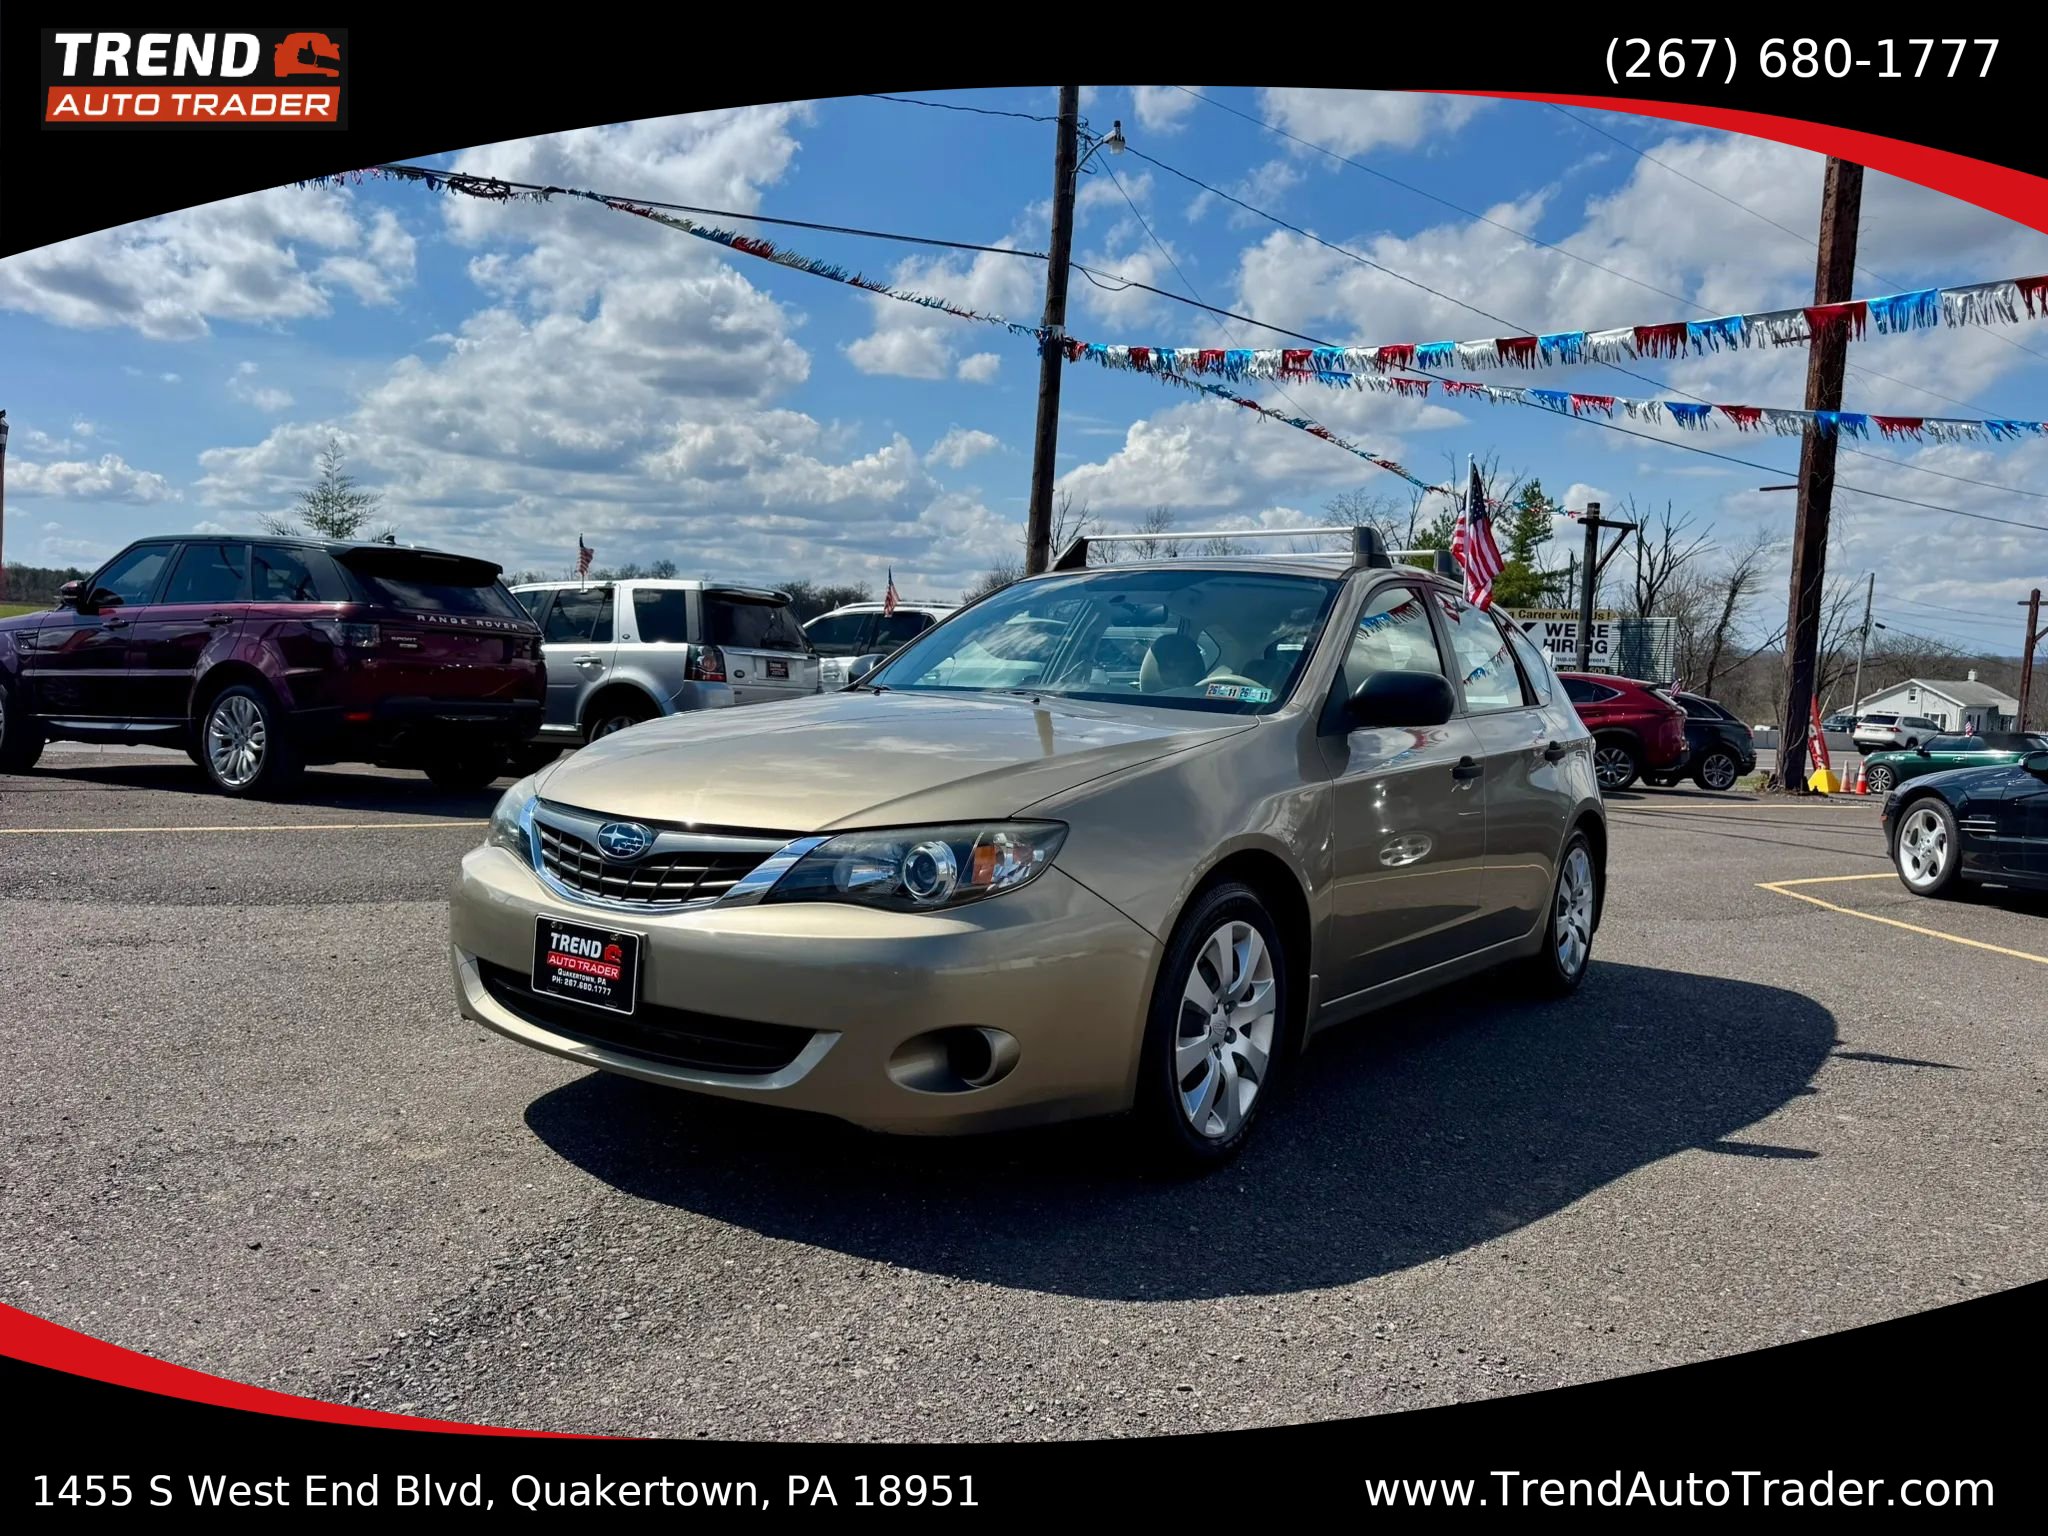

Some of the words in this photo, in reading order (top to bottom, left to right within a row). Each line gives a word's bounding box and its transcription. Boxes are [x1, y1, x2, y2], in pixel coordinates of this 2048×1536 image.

[416, 614, 468, 625] RANGE
[476, 620, 518, 630] ROVER
[1518, 609, 1557, 619] Career
[1561, 610, 1579, 619] wit
[551, 932, 602, 959] TREND
[549, 955, 576, 968] AUTO
[577, 960, 618, 978] TRADER
[552, 975, 563, 984] PH:
[564, 978, 612, 996] 267.680.1777
[597, 977, 606, 986] PA
